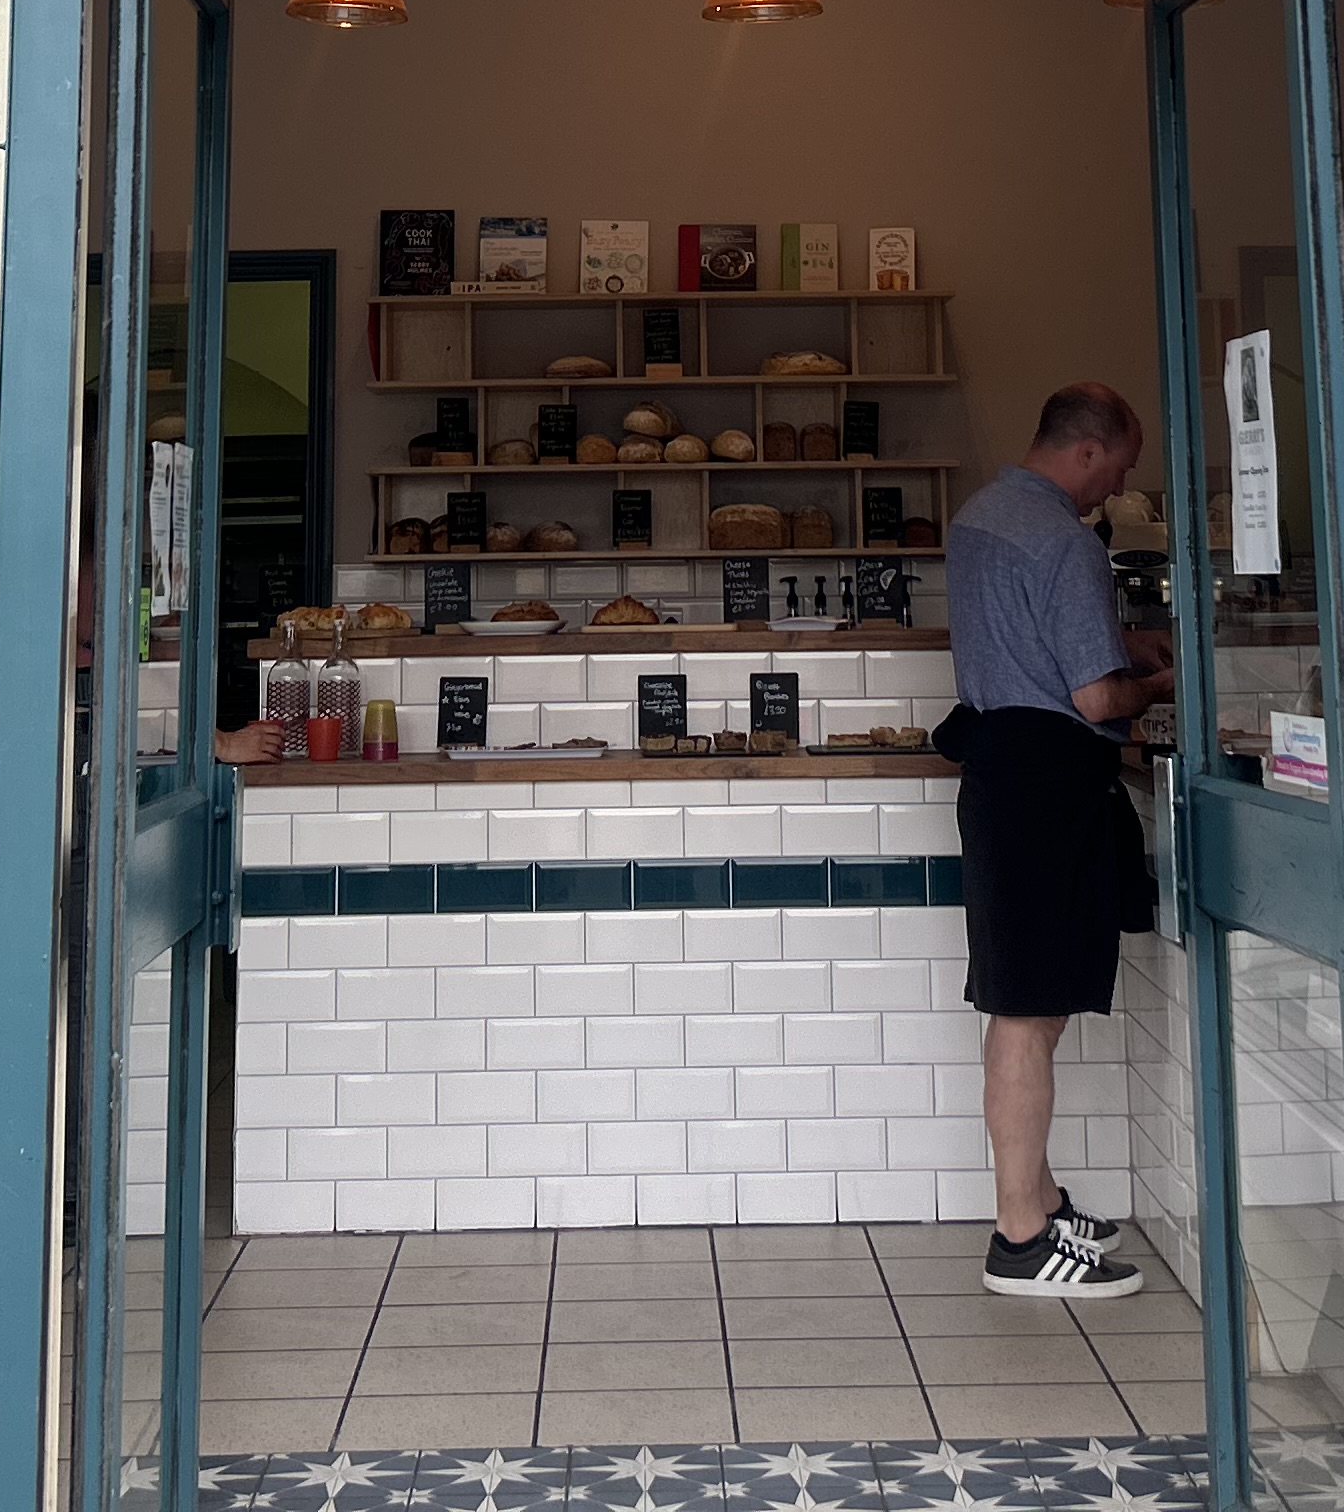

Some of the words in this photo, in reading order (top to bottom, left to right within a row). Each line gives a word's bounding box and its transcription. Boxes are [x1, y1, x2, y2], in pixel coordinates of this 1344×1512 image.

[405, 228, 433, 237] COOK
[408, 237, 430, 246] THAI
[805, 242, 829, 251] GIN
[1146, 719, 1168, 734] TIPS
